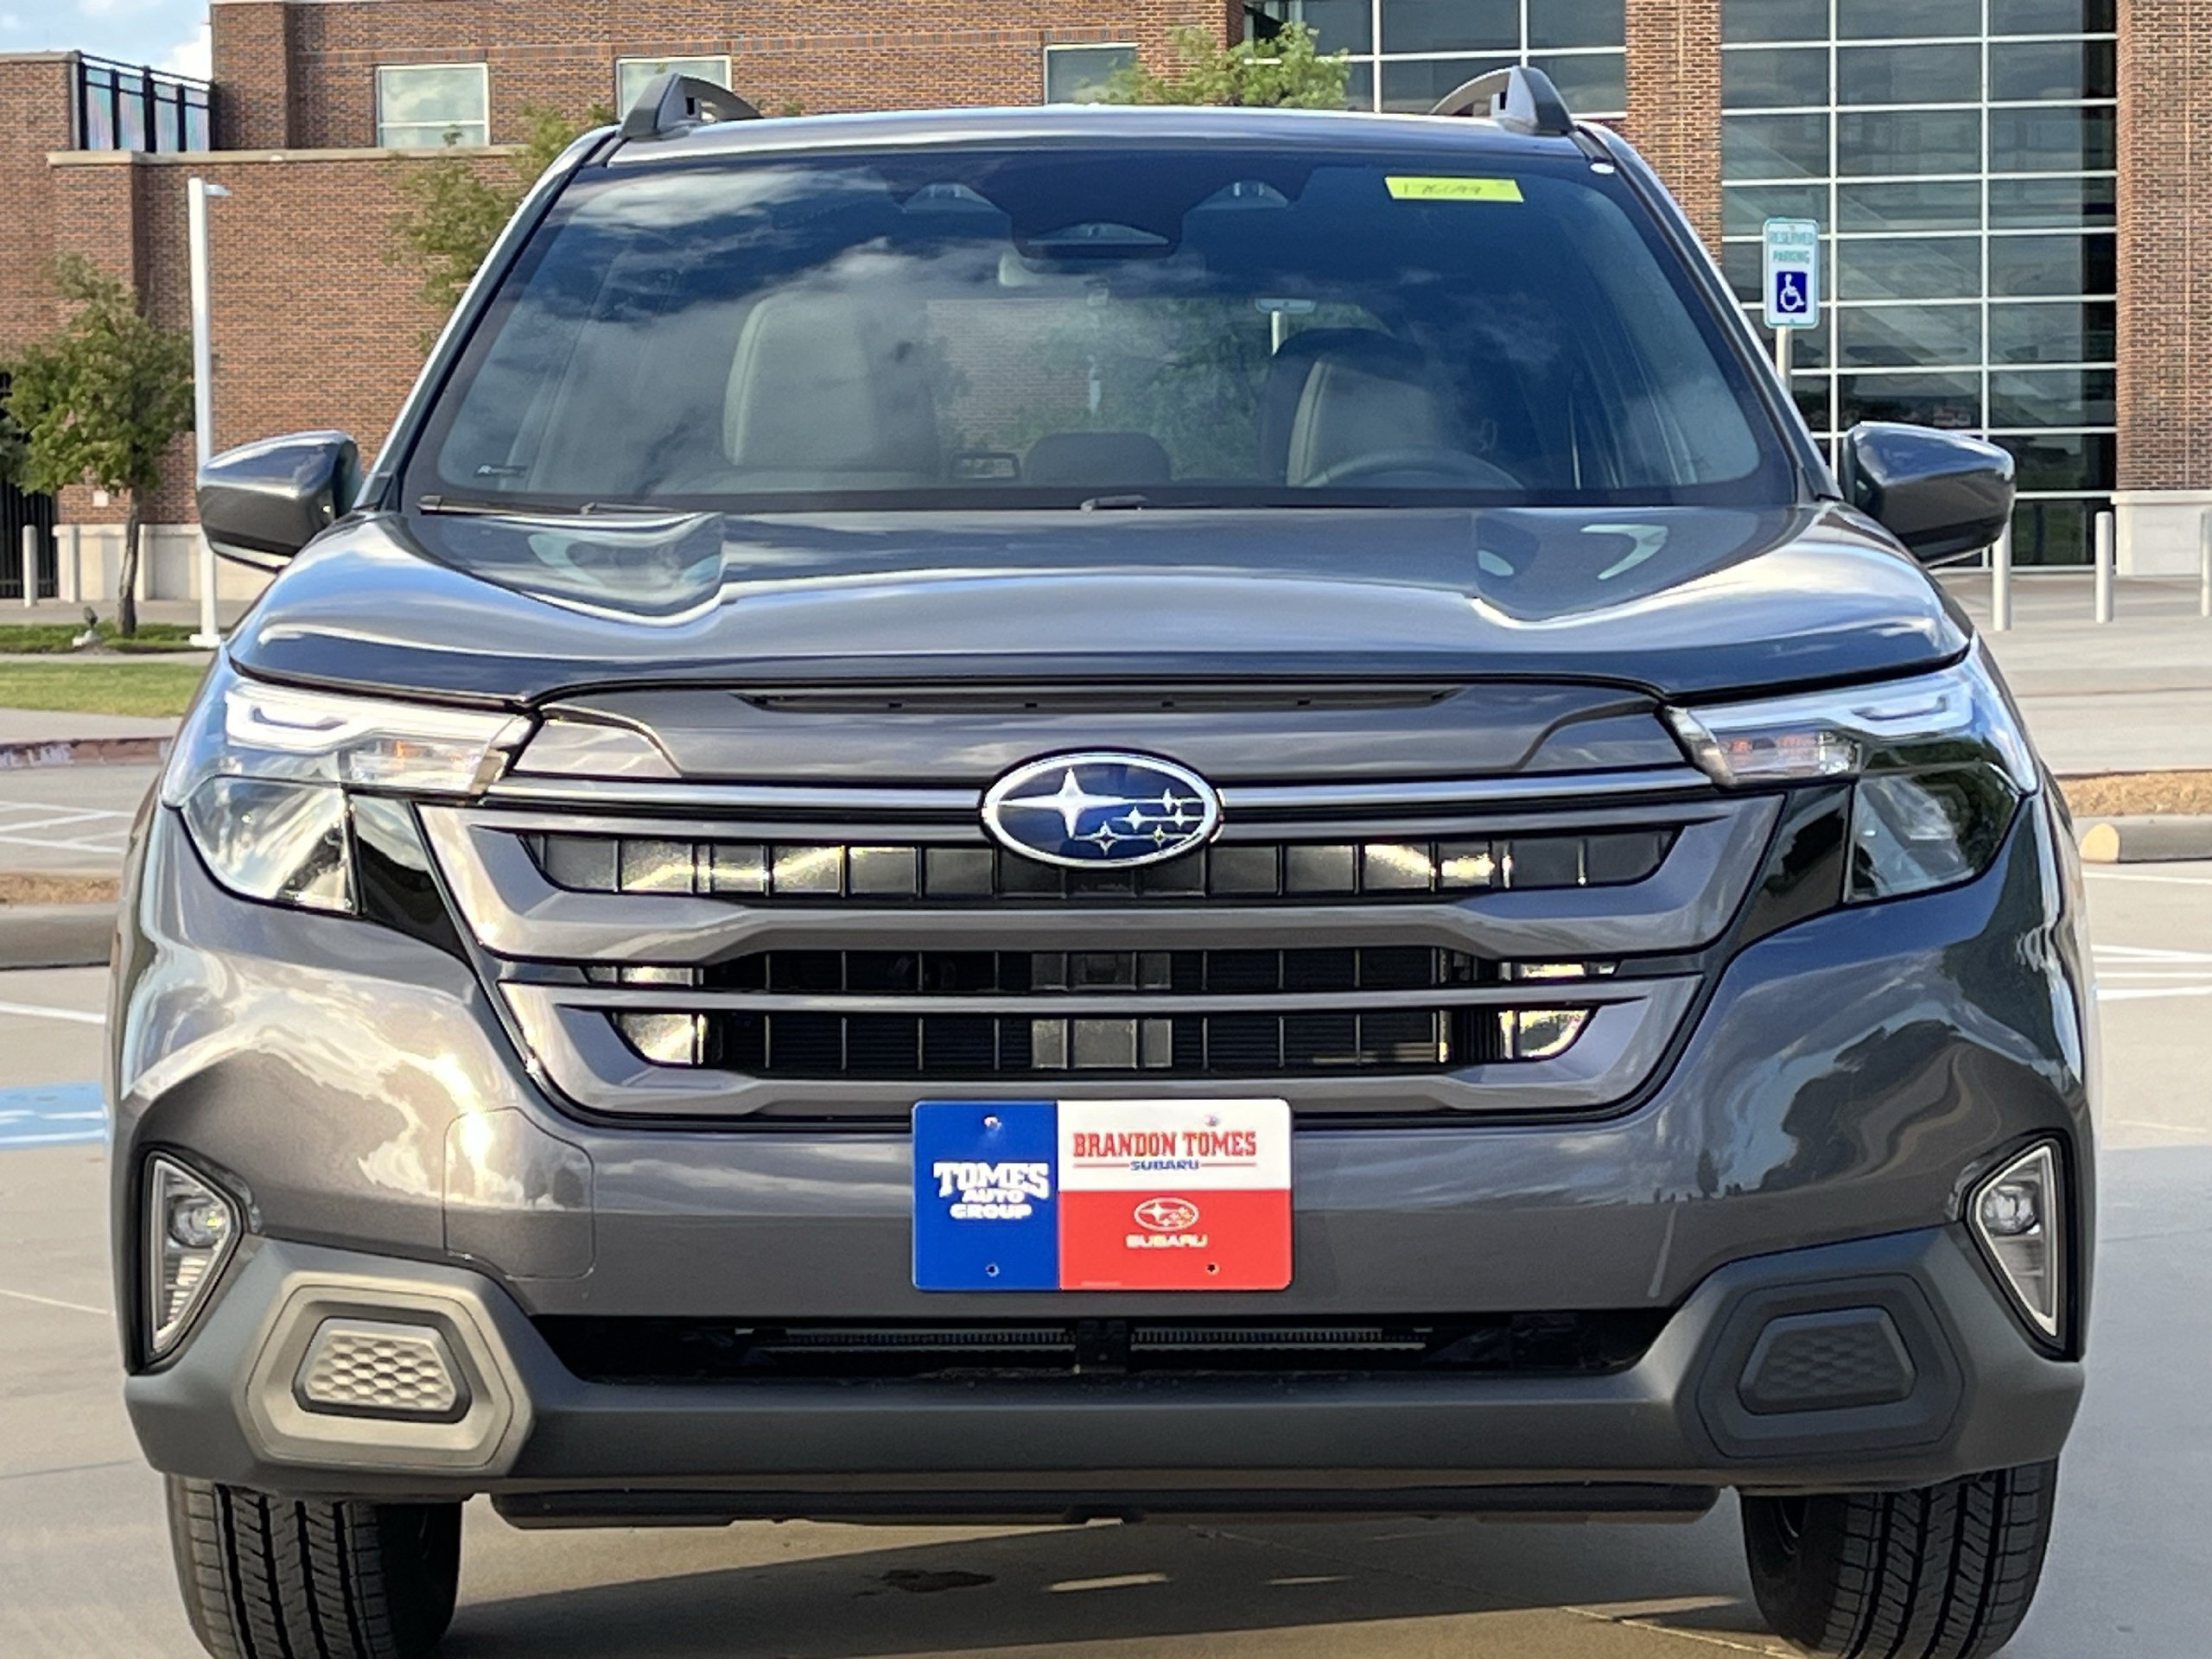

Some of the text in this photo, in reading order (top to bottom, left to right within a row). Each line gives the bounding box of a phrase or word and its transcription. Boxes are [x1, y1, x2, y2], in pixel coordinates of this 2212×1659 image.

[1073, 1131, 1257, 1157] BRANDON TOMES
[1129, 1160, 1199, 1171] SUBARU
[933, 1162, 1049, 1199] TOMES
[962, 1189, 1025, 1203] AUTO
[950, 1204, 1033, 1219] GROUP
[1125, 1234, 1209, 1249] SUBARU
